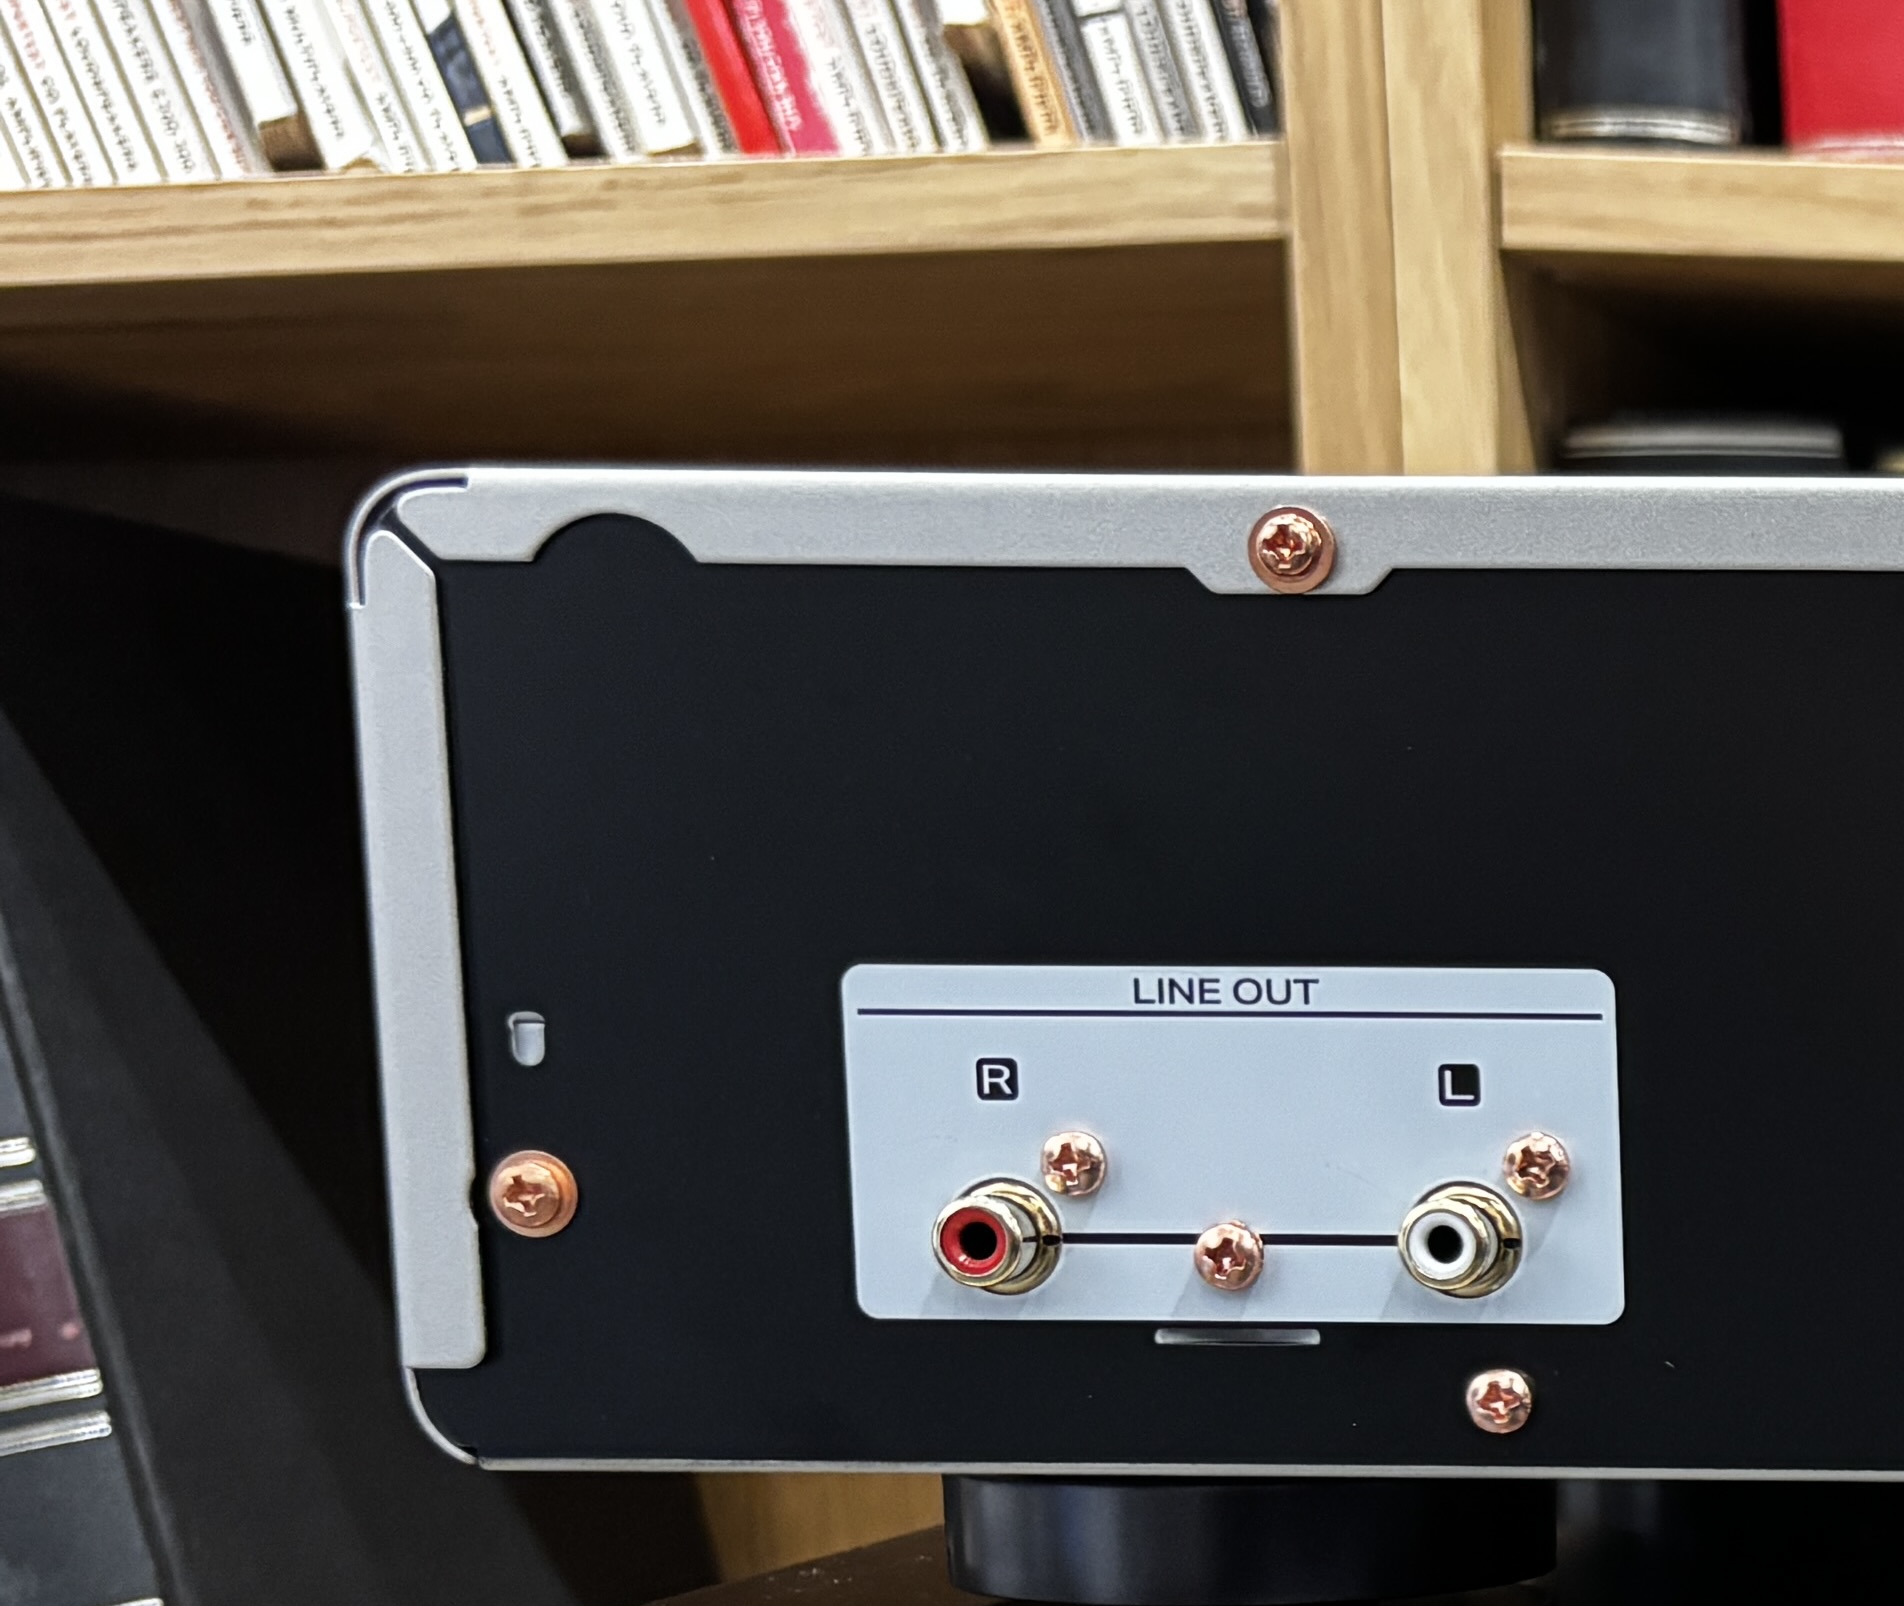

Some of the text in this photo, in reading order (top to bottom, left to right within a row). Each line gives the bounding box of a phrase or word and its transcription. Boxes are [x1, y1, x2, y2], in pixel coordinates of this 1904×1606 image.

[1134, 978, 1319, 1005] LINE OUT
[983, 1065, 1011, 1094] R
[1443, 1069, 1474, 1100] L
